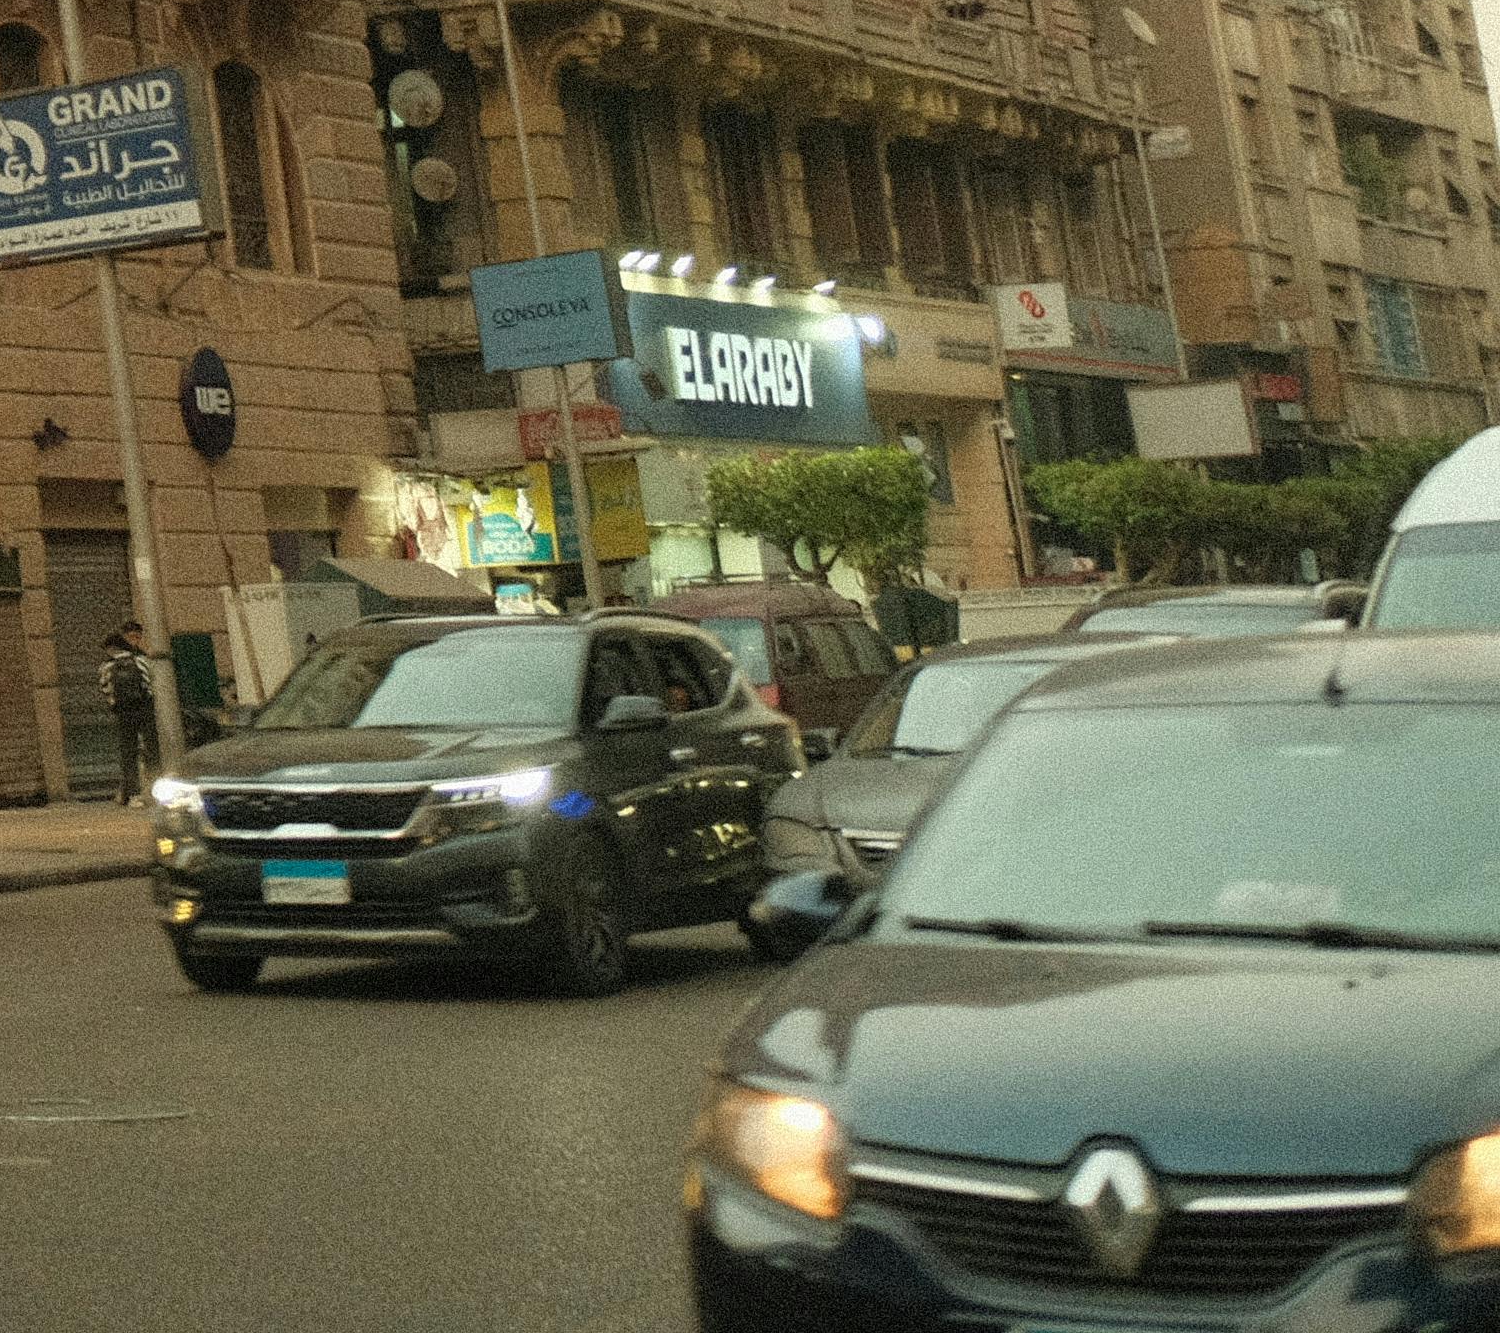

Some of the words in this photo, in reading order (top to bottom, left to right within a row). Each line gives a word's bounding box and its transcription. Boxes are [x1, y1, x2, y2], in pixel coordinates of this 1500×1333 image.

[47, 79, 173, 127] GRAND
[59, 138, 181, 182] جراند
[666, 326, 814, 409] ELARABY
